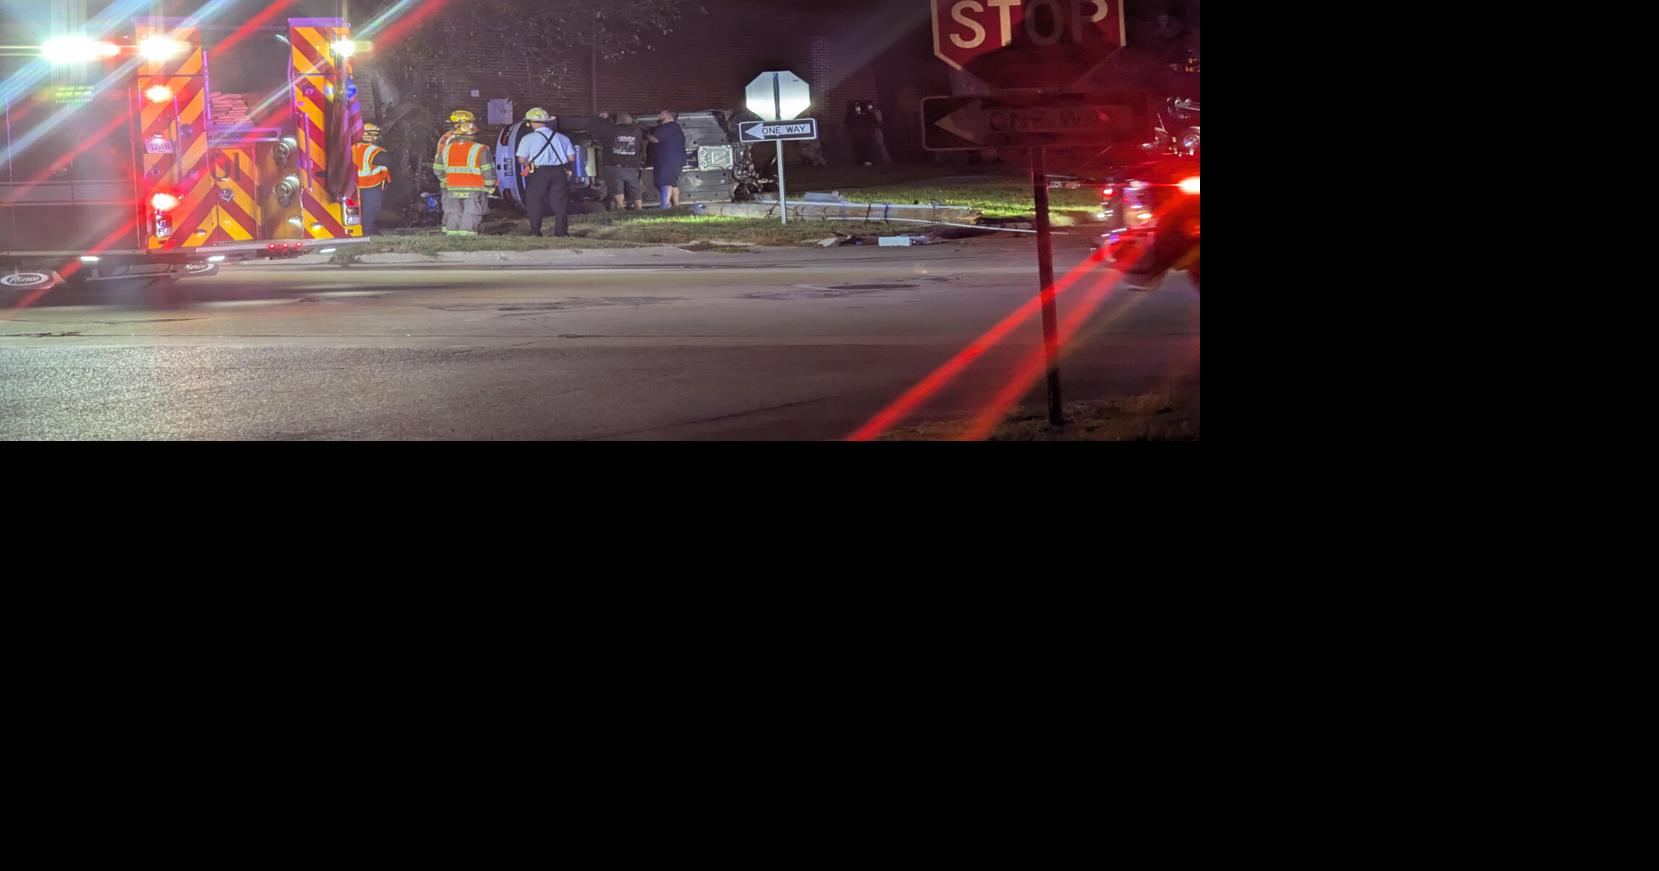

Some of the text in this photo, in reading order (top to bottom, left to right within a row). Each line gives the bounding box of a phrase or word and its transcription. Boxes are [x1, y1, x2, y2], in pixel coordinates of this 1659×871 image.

[949, 0, 1109, 49] STOP
[761, 125, 806, 135] ONE WAY
